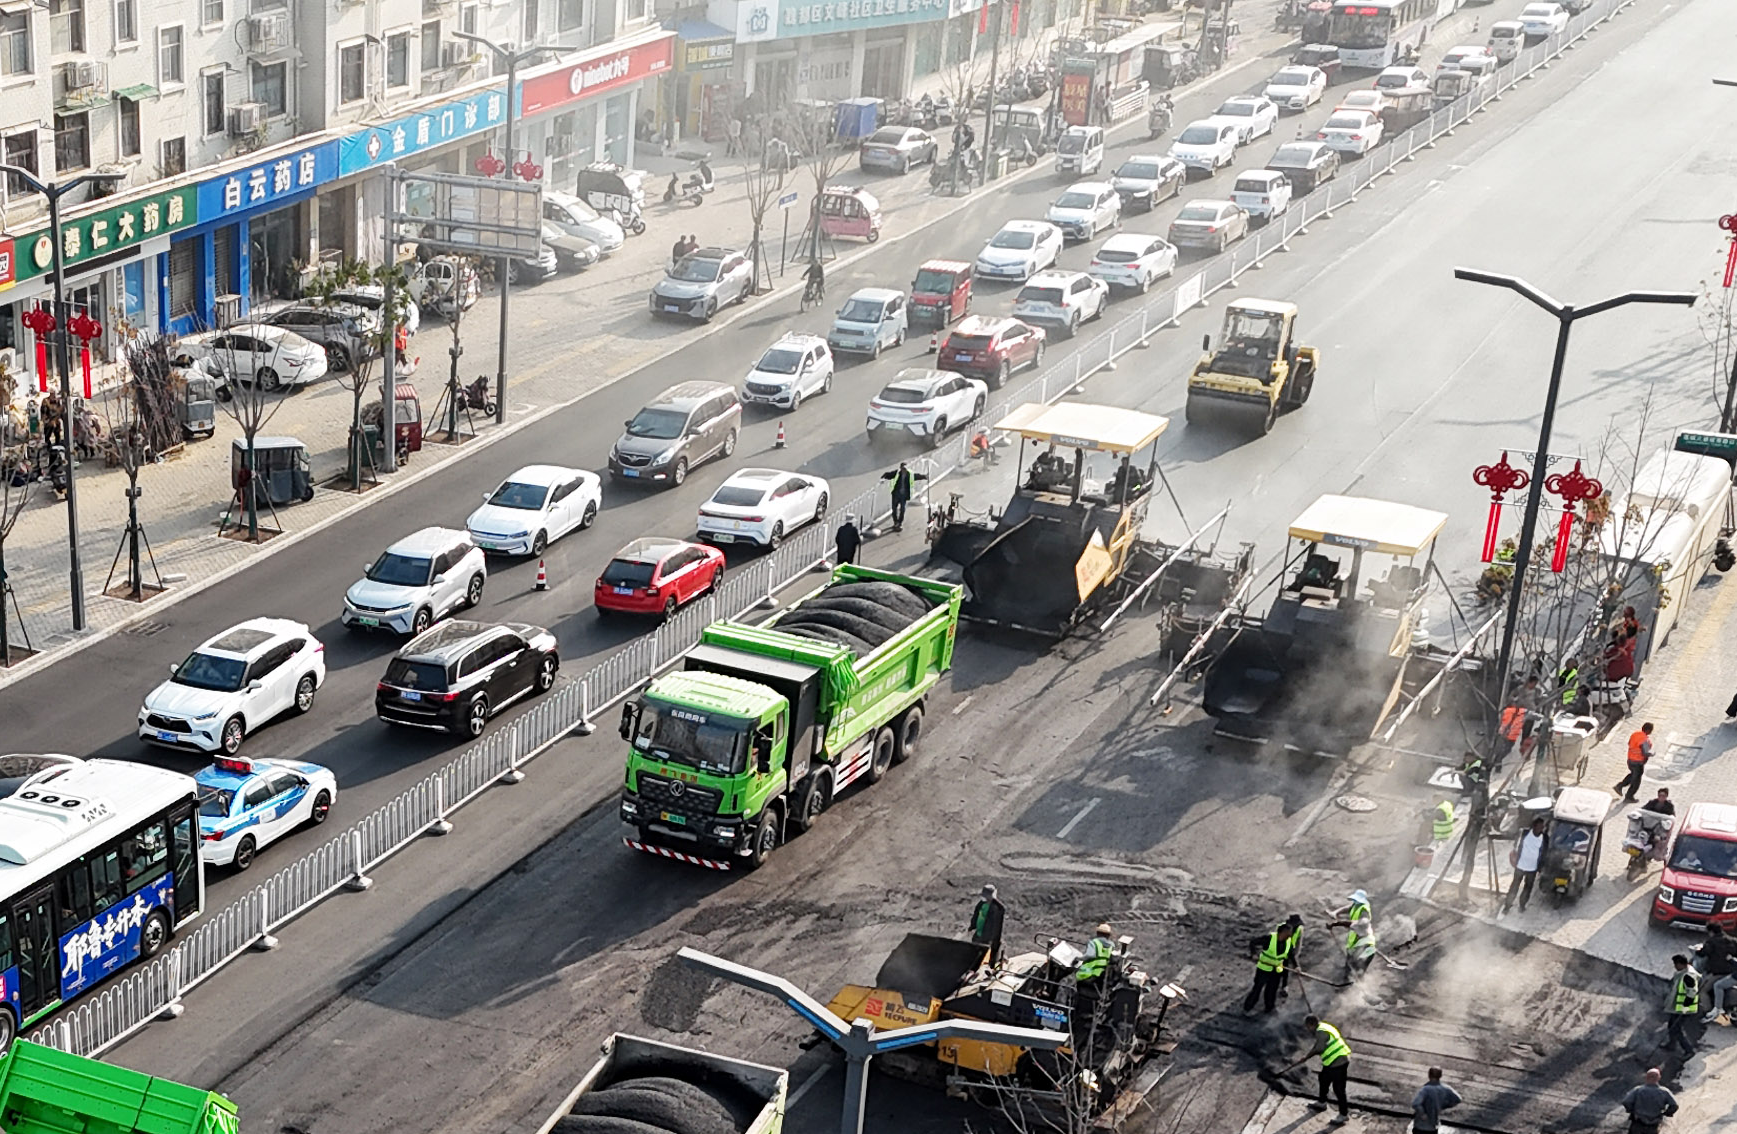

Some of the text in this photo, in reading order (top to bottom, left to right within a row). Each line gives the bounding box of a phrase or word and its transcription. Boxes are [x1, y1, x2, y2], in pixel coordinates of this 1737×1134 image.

[392, 94, 501, 154] 金盾门诊部
[224, 149, 316, 211] 白云药店
[1335, 535, 1369, 547] VOLVO
[62, 894, 153, 981] 耶鲁专升本
